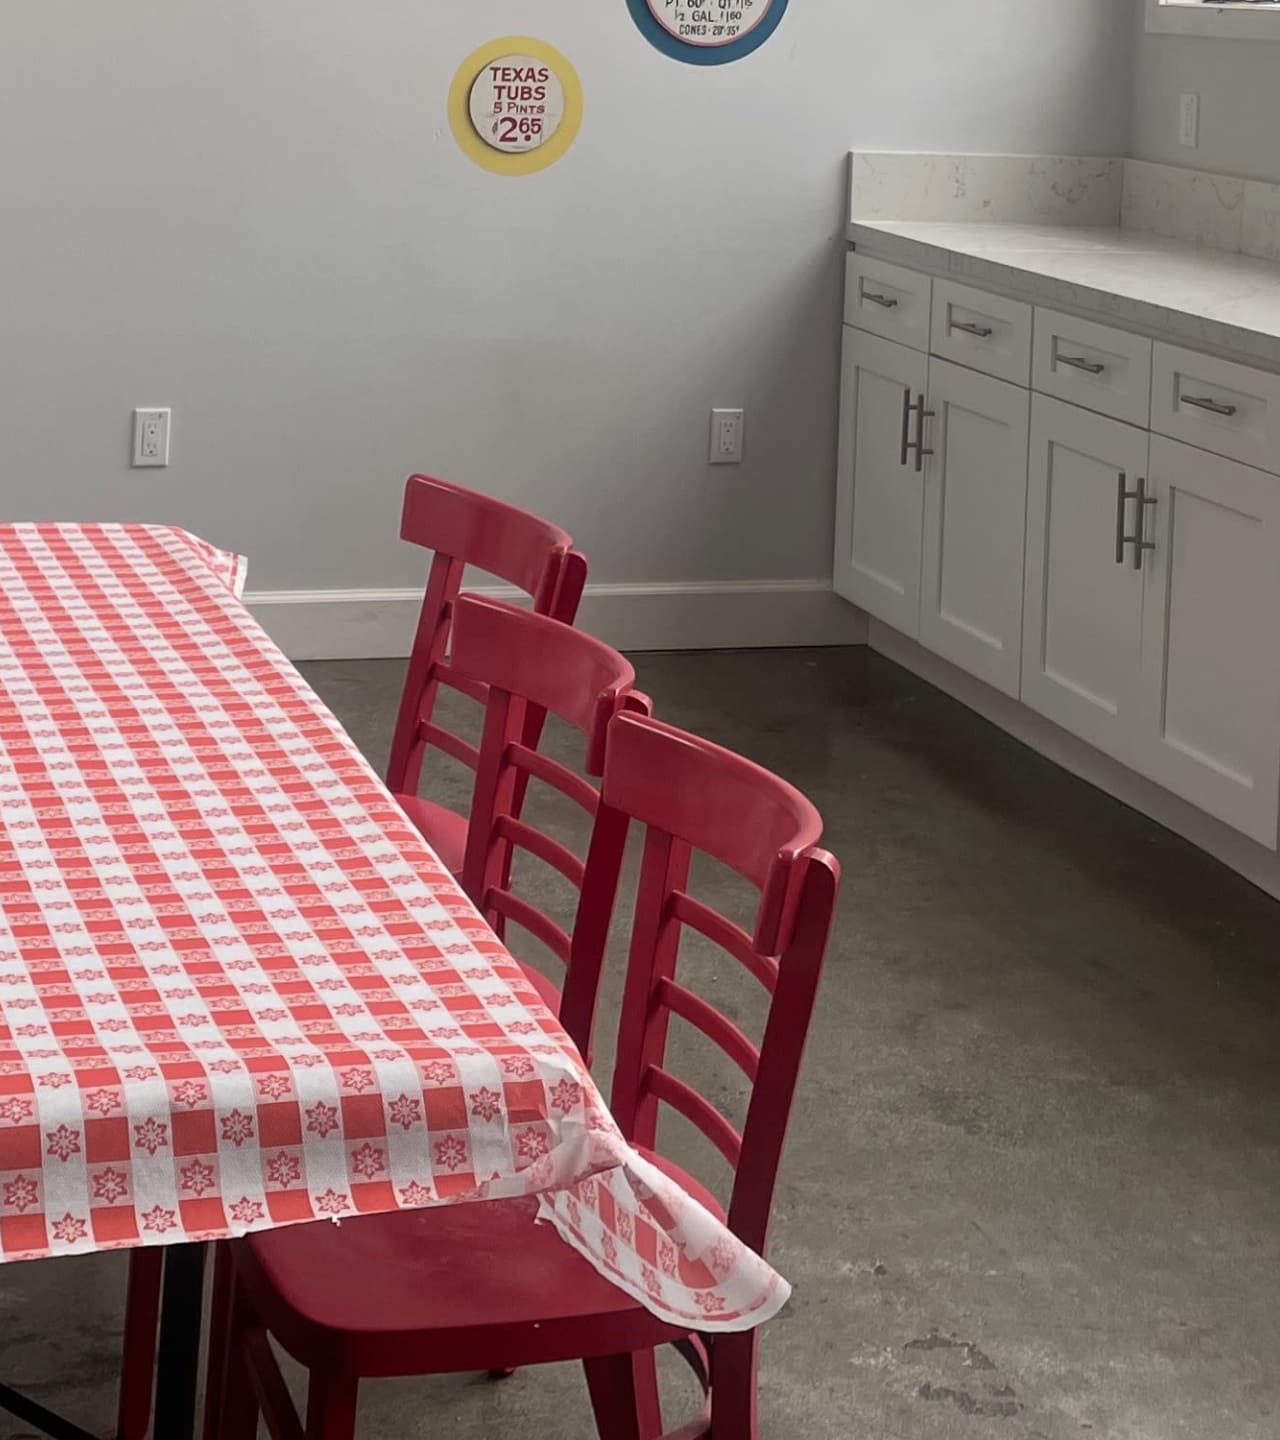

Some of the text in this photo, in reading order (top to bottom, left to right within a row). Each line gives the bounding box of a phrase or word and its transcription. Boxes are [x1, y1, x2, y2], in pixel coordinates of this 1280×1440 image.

[490, 67, 549, 82] TEXAS
[494, 85, 546, 101] TUBS
[494, 102, 502, 114] 5
